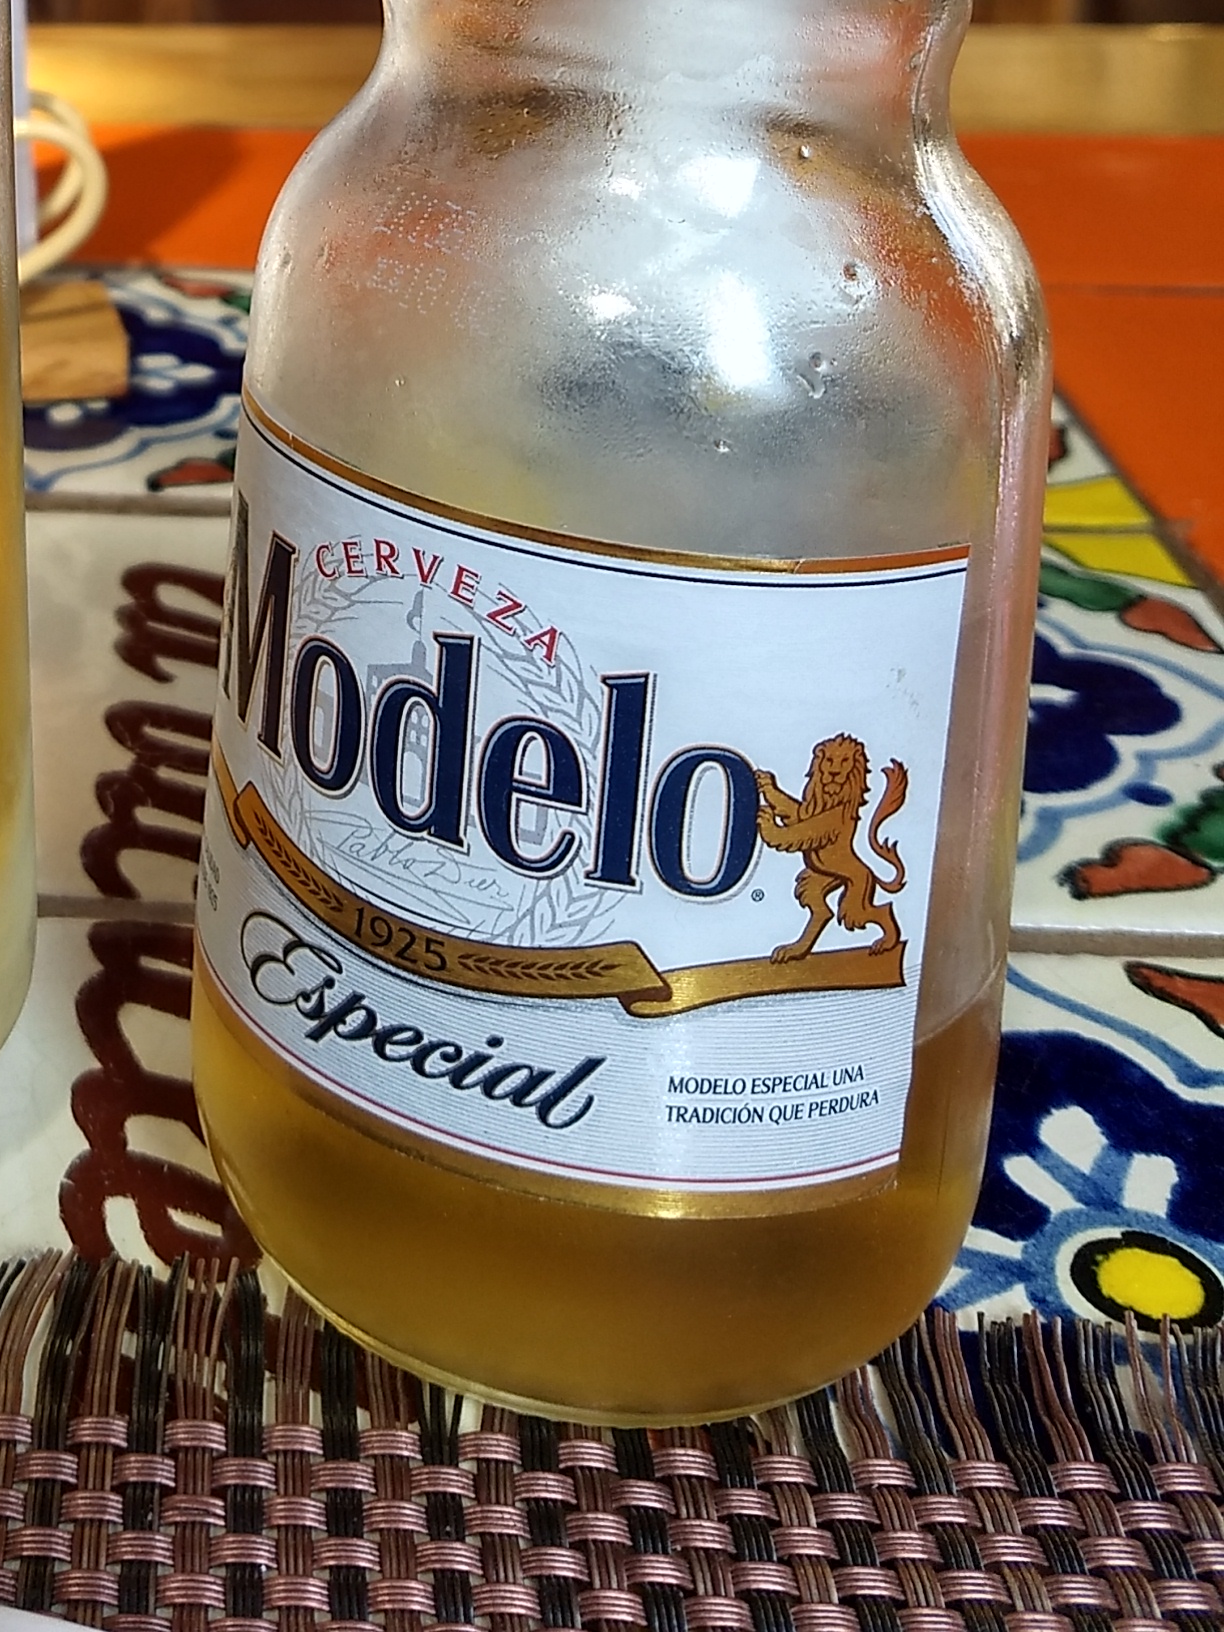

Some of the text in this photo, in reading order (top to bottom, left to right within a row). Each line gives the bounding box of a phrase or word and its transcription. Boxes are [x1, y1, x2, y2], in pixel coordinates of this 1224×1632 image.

[315, 538, 561, 666] CERVEZA
[222, 489, 765, 900] Modelo
[353, 905, 448, 972] 1925
[240, 910, 608, 1130] Especial
[665, 1089, 880, 1125] TRADICIÓN QUE PERDURA
[667, 1064, 865, 1095] MODELO ESPECIAL UNA
